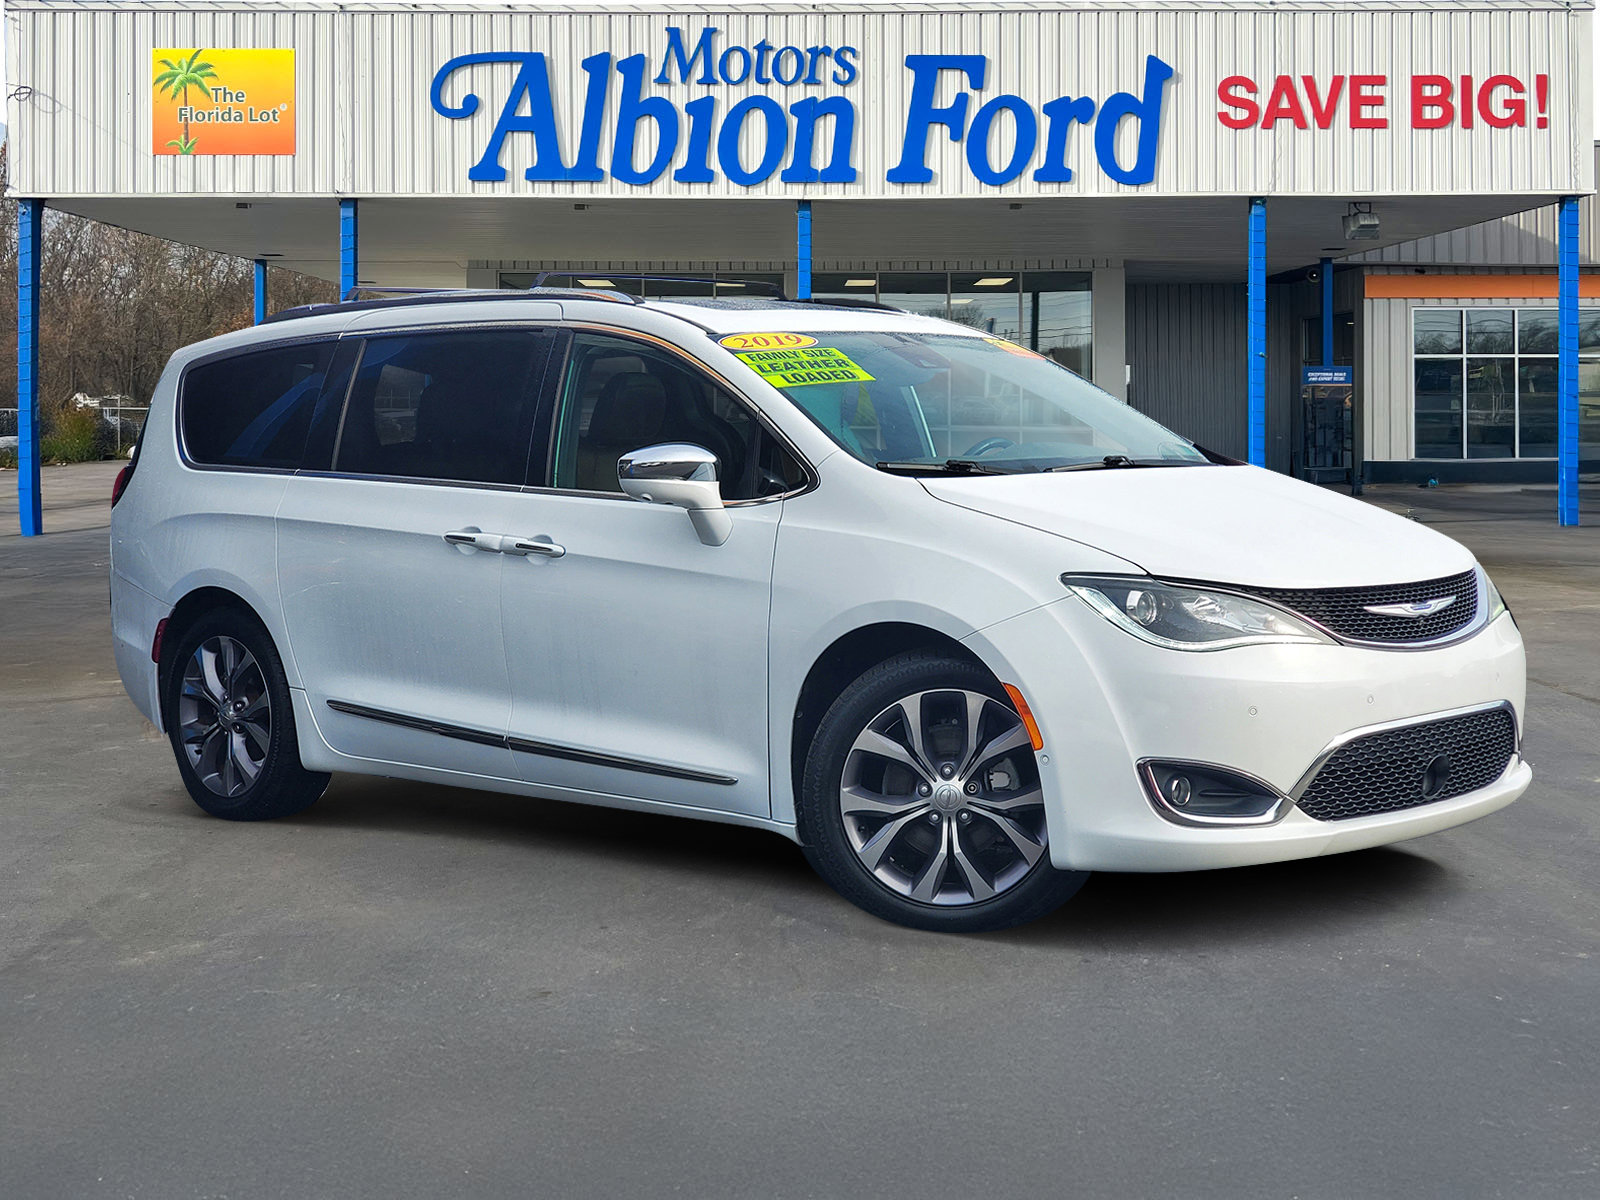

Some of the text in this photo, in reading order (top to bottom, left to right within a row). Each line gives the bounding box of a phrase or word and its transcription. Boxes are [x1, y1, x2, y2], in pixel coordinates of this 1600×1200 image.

[654, 28, 856, 84] Motors
[211, 86, 246, 103] The
[1217, 75, 1548, 129] SAVE BIG!
[178, 106, 280, 122] Florida Lot
[431, 52, 1174, 186] Albion Ford
[733, 334, 804, 349] 2019
[745, 348, 838, 363] FAMILY SIZE
[755, 358, 851, 374] LEATHER
[780, 369, 858, 385] LOADED
